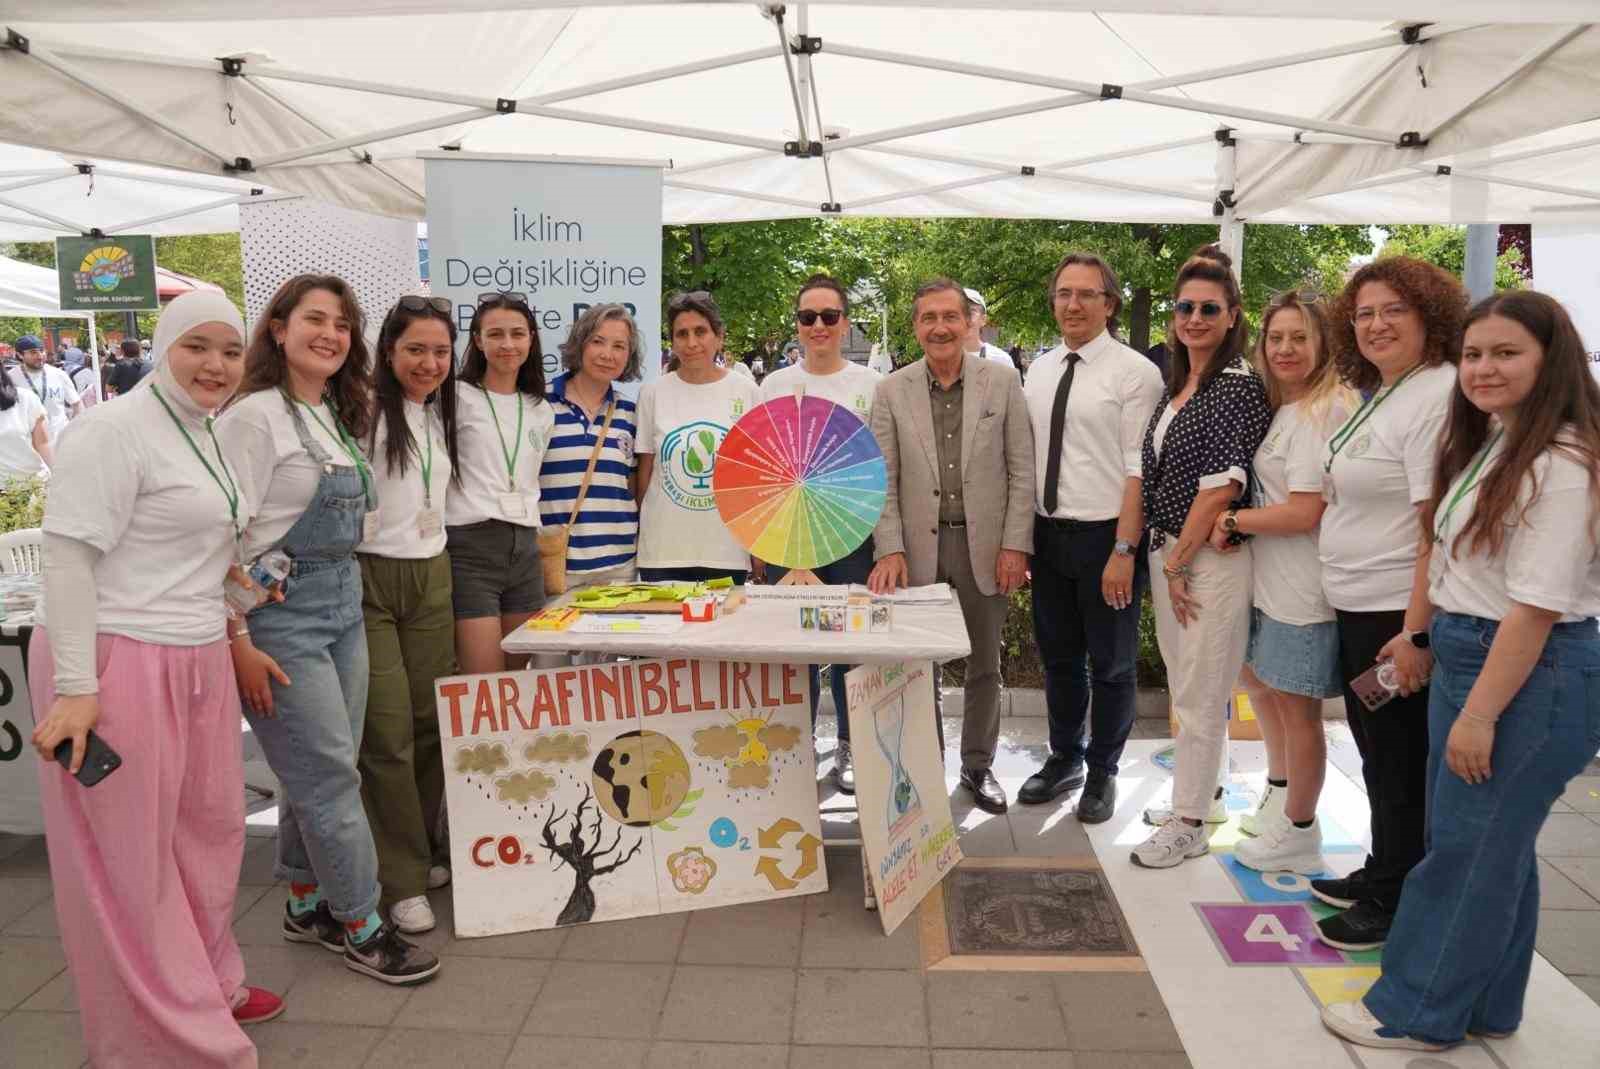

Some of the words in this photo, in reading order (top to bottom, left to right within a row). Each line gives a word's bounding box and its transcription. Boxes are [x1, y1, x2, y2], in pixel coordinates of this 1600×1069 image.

[513, 207, 583, 242] İklim
[446, 258, 646, 293] Değişikliğine
[1243, 914, 1303, 951] 4
